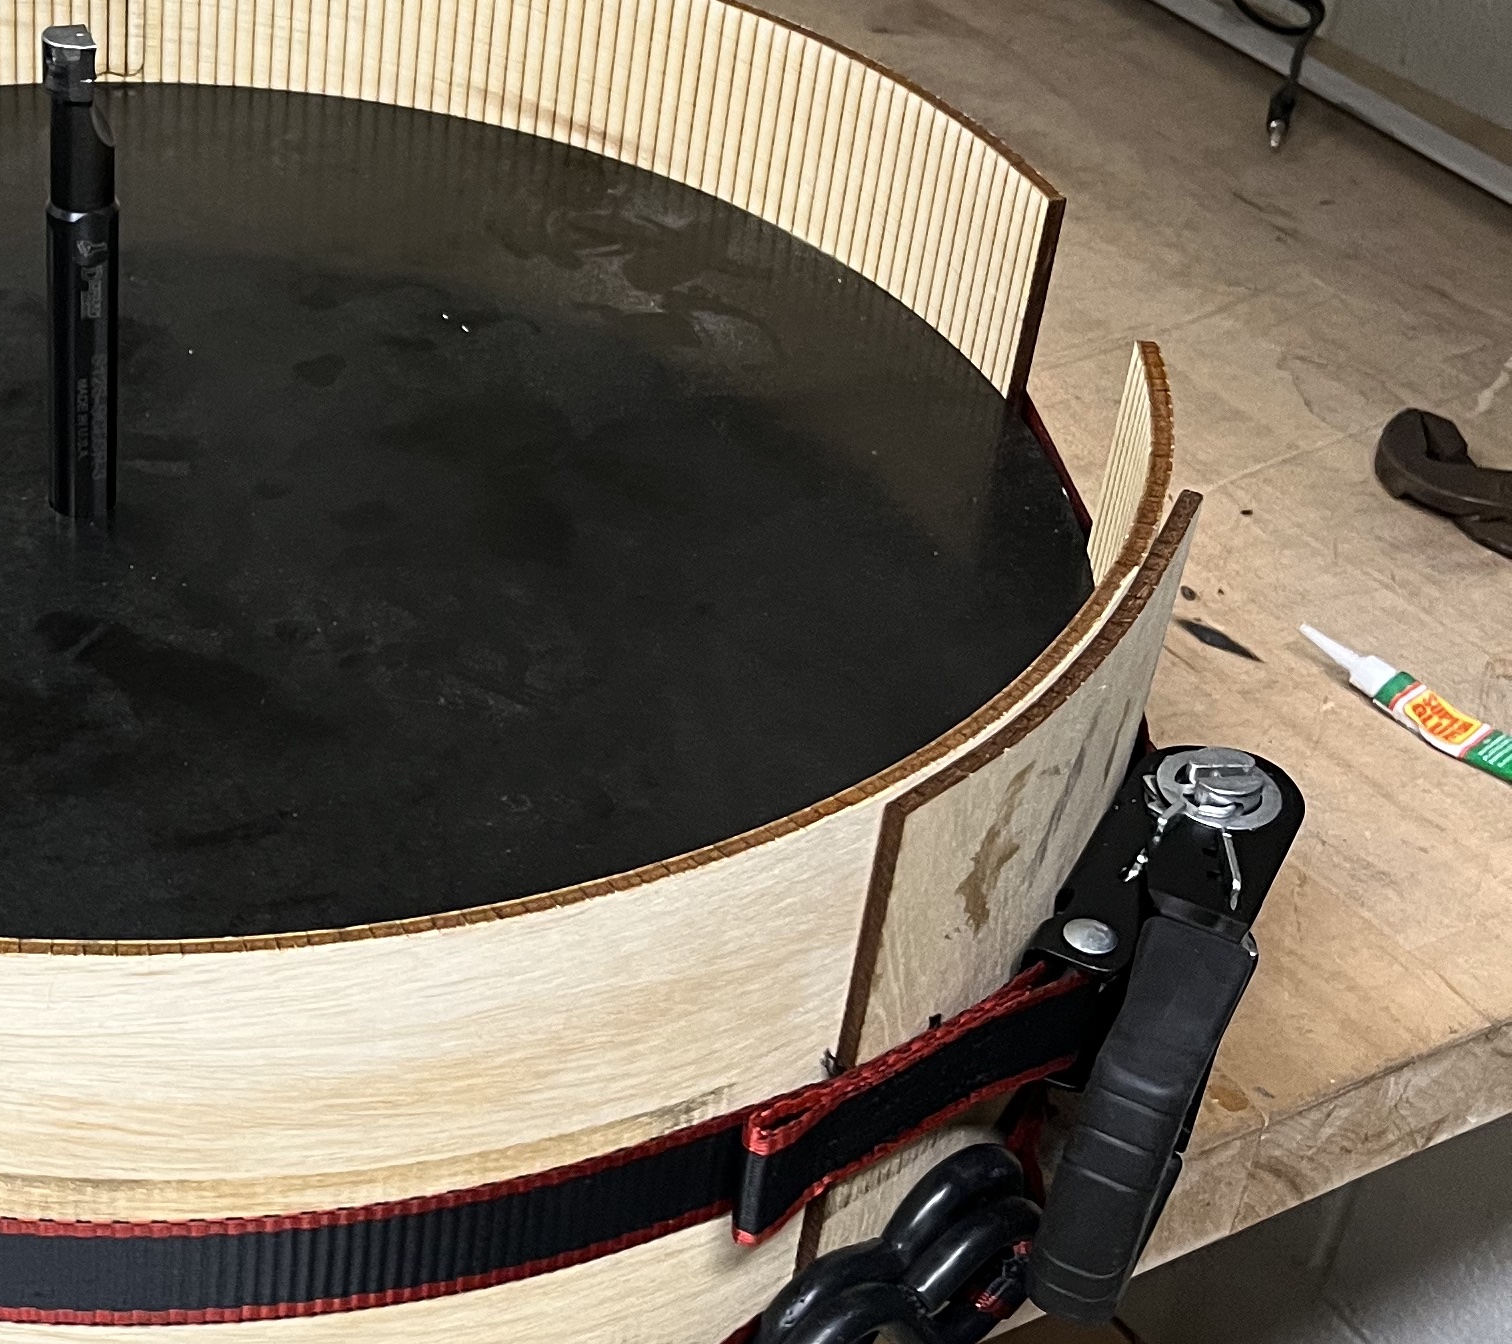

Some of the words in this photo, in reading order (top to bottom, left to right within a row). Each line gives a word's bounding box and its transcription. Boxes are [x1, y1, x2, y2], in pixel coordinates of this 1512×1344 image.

[76, 378, 88, 412] MADE
[1411, 703, 1458, 742] GLUE
[1422, 692, 1475, 735] SUPER
